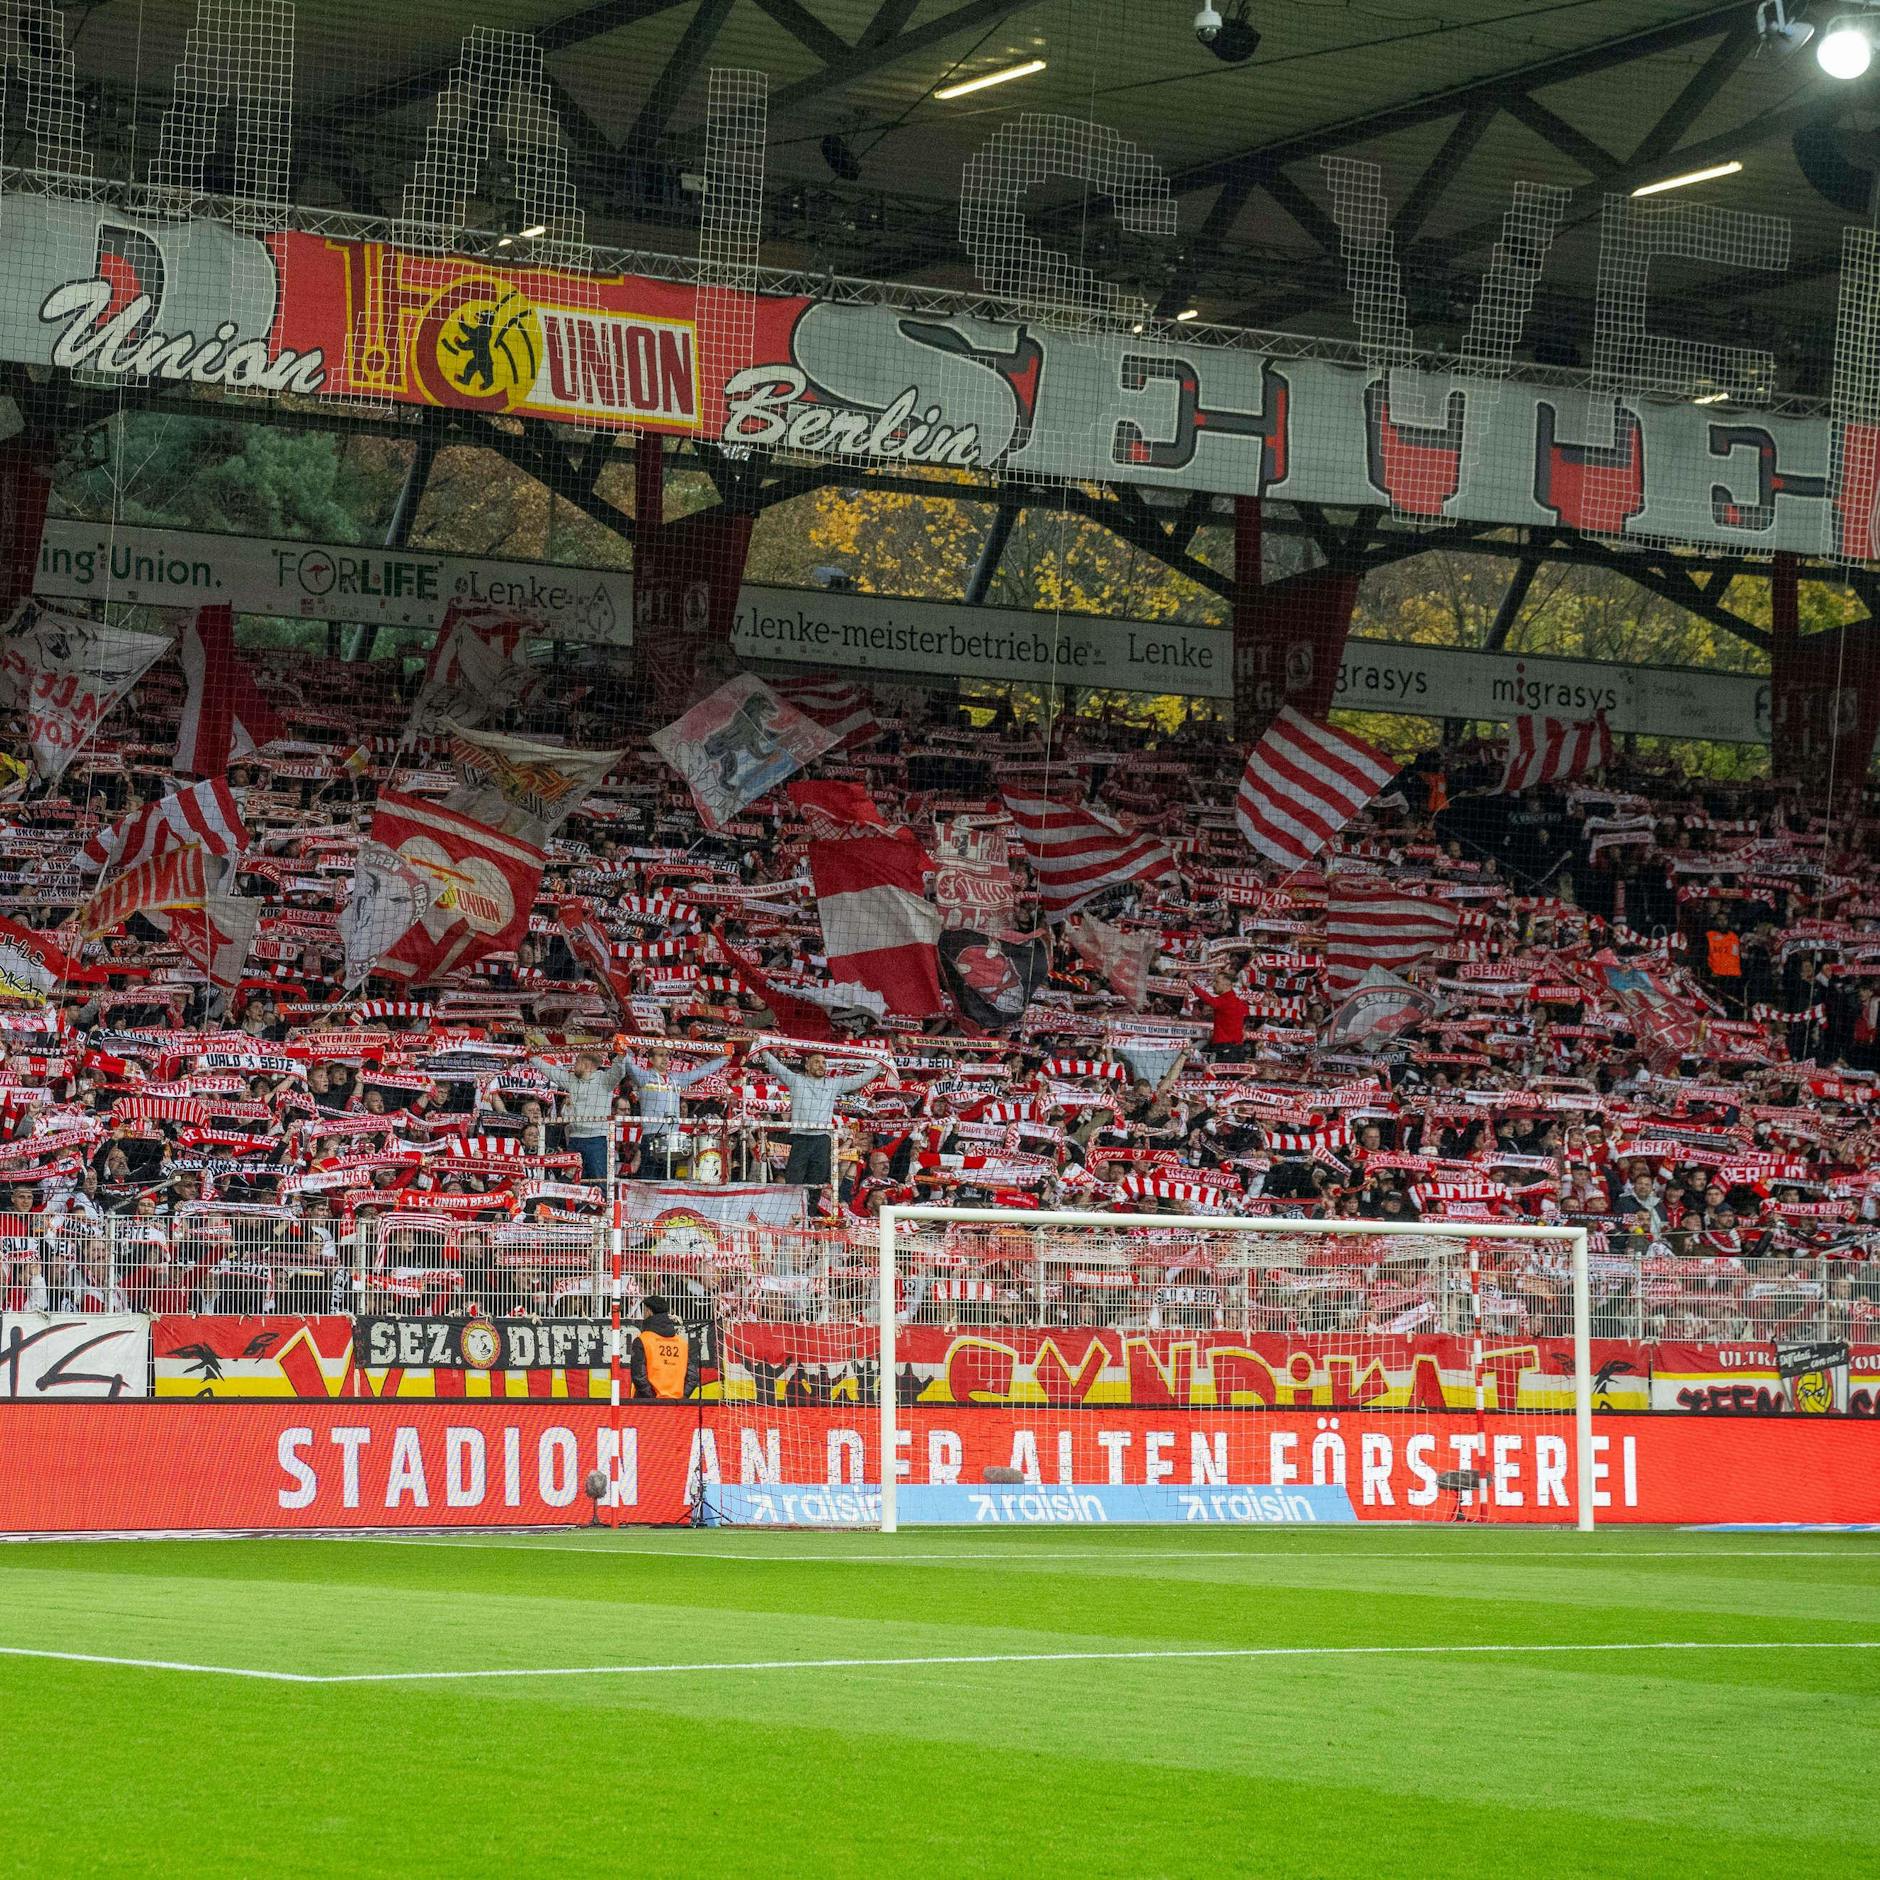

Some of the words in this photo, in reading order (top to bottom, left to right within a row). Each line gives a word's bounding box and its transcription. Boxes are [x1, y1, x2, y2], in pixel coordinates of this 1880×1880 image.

[38, 275, 327, 392] Union
[542, 316, 696, 415] UNION
[724, 361, 982, 466] Berlin
[468, 571, 570, 610] Lenke
[1128, 633, 1214, 669] Lenke
[1492, 662, 1617, 711] migrasys
[460, 888, 500, 923] UNION
[256, 943, 281, 959] UNION
[1537, 985, 1581, 998] UNIONER
[626, 1036, 664, 1048] WUHLE
[672, 1040, 725, 1053] SYNDIKAT
[206, 1054, 241, 1069] WALD
[260, 1056, 294, 1073] SEITE
[497, 1076, 537, 1090] WALD
[934, 1081, 964, 1096] WALD
[203, 1131, 250, 1147] UNION
[1089, 1150, 1126, 1164] Eisern
[341, 1170, 369, 1184] 1966
[1165, 1168, 1201, 1182] EISERN
[1203, 1171, 1238, 1188] UNION
[1720, 1165, 1808, 1184] BERLIN
[1425, 1182, 1510, 1200] UNION
[418, 1197, 432, 1209] FC
[433, 1194, 468, 1209] UNION
[470, 1193, 508, 1208] BERLIN
[370, 1321, 462, 1365] SEZ.
[658, 1345, 680, 1358] 282
[278, 1425, 638, 1508] STADION
[1270, 1417, 1639, 1507] FÖRSTEREI
[1002, 1486, 1108, 1522] raisin
[1210, 1486, 1316, 1522] raisin
